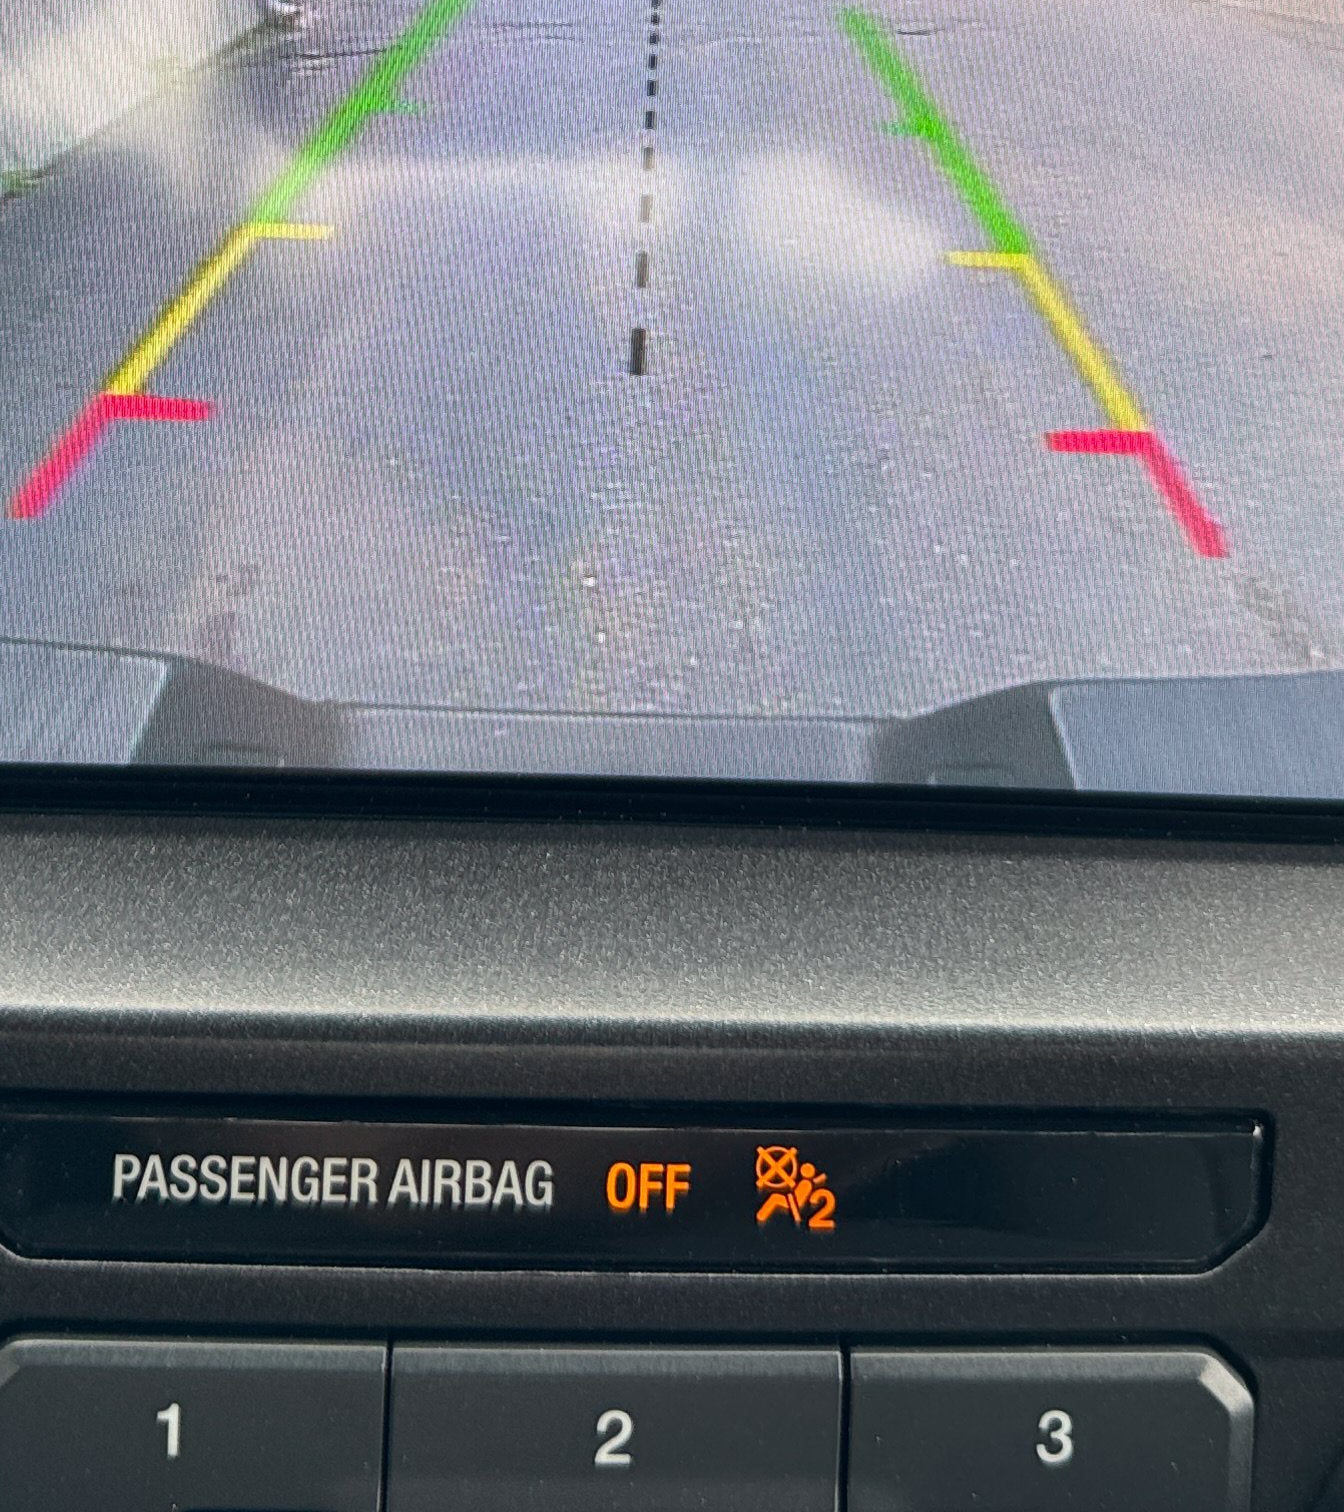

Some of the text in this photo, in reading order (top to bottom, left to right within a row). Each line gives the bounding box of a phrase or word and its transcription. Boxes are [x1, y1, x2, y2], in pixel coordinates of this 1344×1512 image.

[112, 1153, 692, 1211] PASSENGER AIRBAG OFF
[808, 1194, 837, 1230] 2
[154, 1402, 181, 1459] 1
[593, 1409, 634, 1466] 2
[1034, 1408, 1076, 1465] 3
